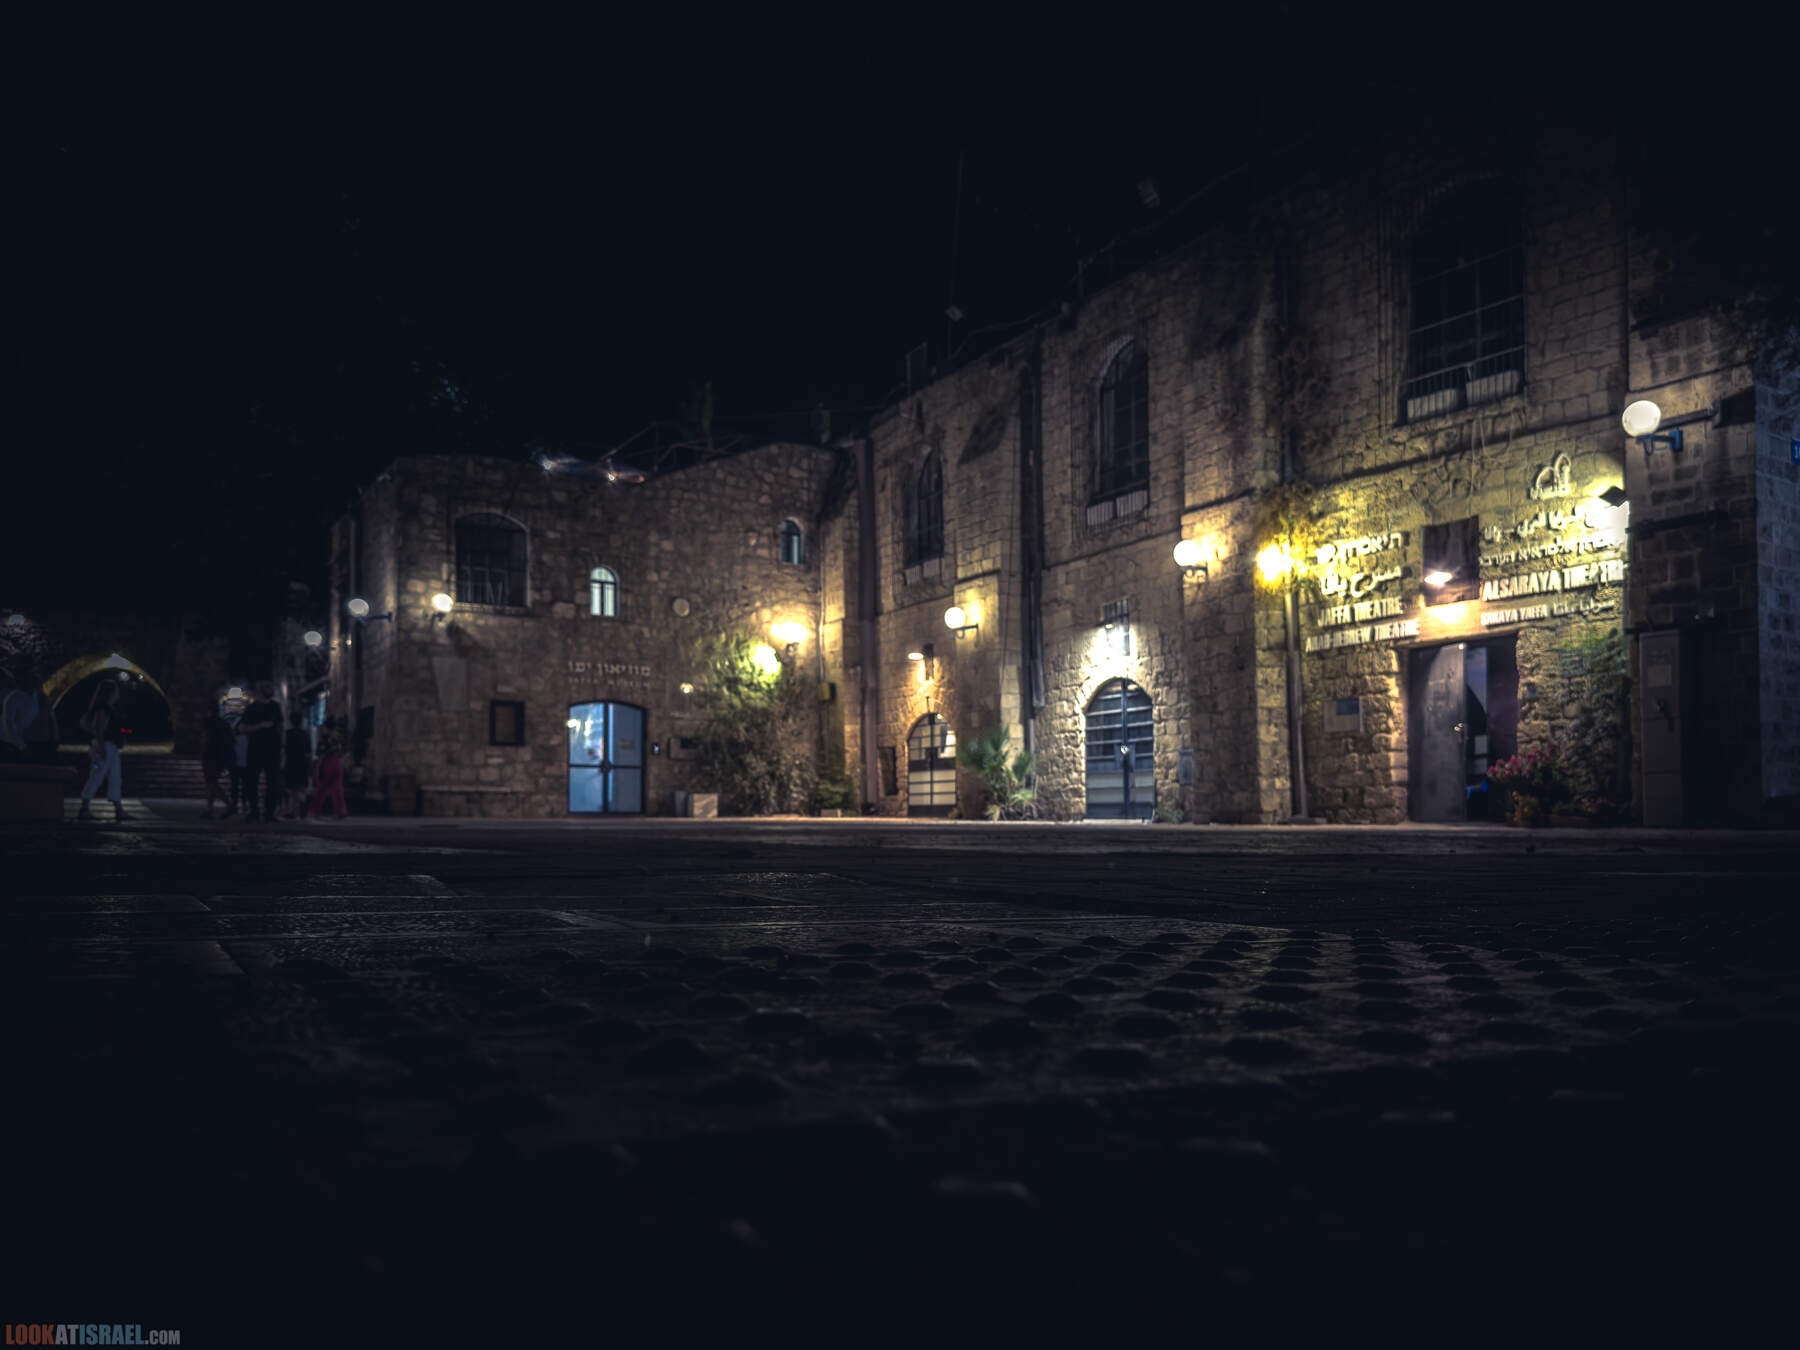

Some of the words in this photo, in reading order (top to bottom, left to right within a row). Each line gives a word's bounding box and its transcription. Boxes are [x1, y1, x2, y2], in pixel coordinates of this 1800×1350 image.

[1481, 570, 1561, 601] ALSARAYA
[1317, 604, 1350, 627] JAFFA
[1354, 596, 1404, 621] THEATRE
